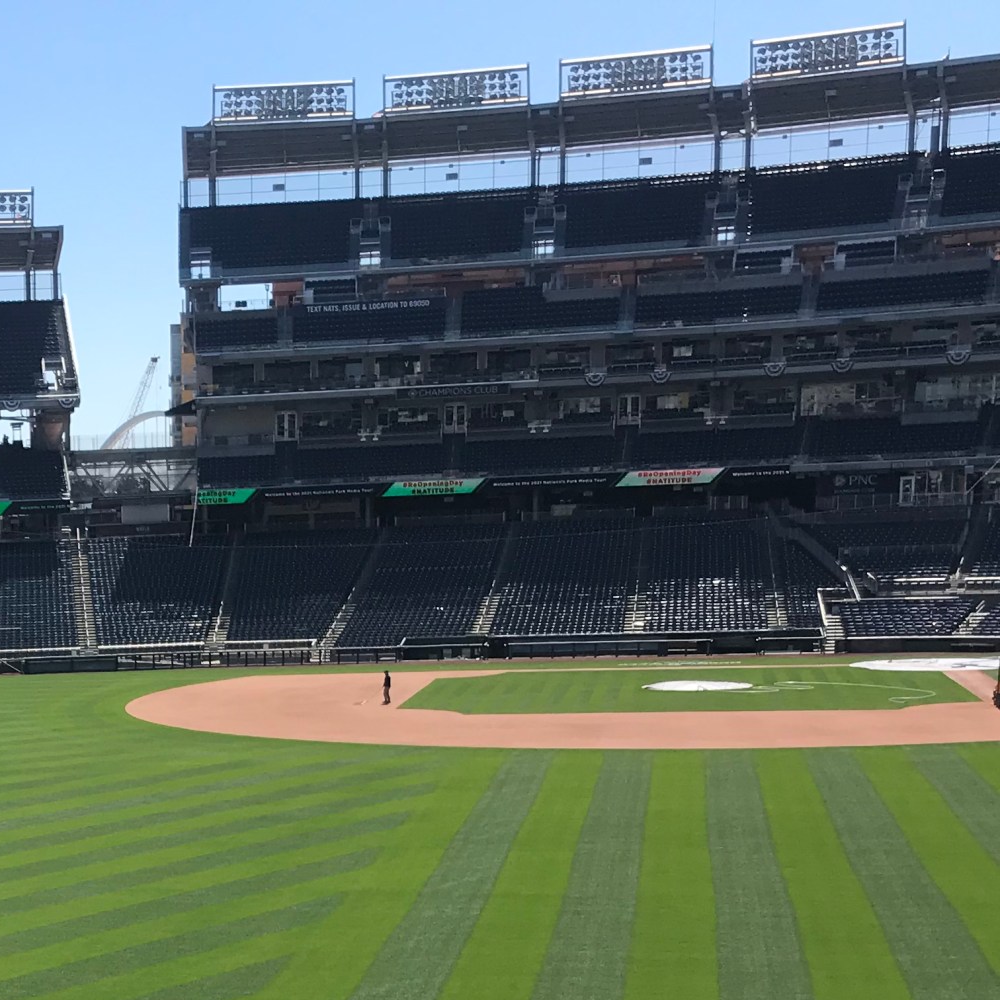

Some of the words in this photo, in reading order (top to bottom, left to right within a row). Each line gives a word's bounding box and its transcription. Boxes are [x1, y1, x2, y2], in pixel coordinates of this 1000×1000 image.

[306, 305, 322, 313] TEXT
[342, 303, 360, 312] ISSUE
[361, 303, 367, 311] &
[368, 301, 399, 311] LOCATION
[399, 300, 408, 310] TO
[418, 386, 472, 397] CHAMPIONS
[473, 384, 499, 394] CLUB
[637, 469, 702, 478] #ReOpeningDay
[402, 479, 464, 488] #ReOpeningDay
[646, 476, 693, 485] #NATITUDE
[848, 473, 878, 486] PNC
[411, 486, 455, 495] #NATITUDE
